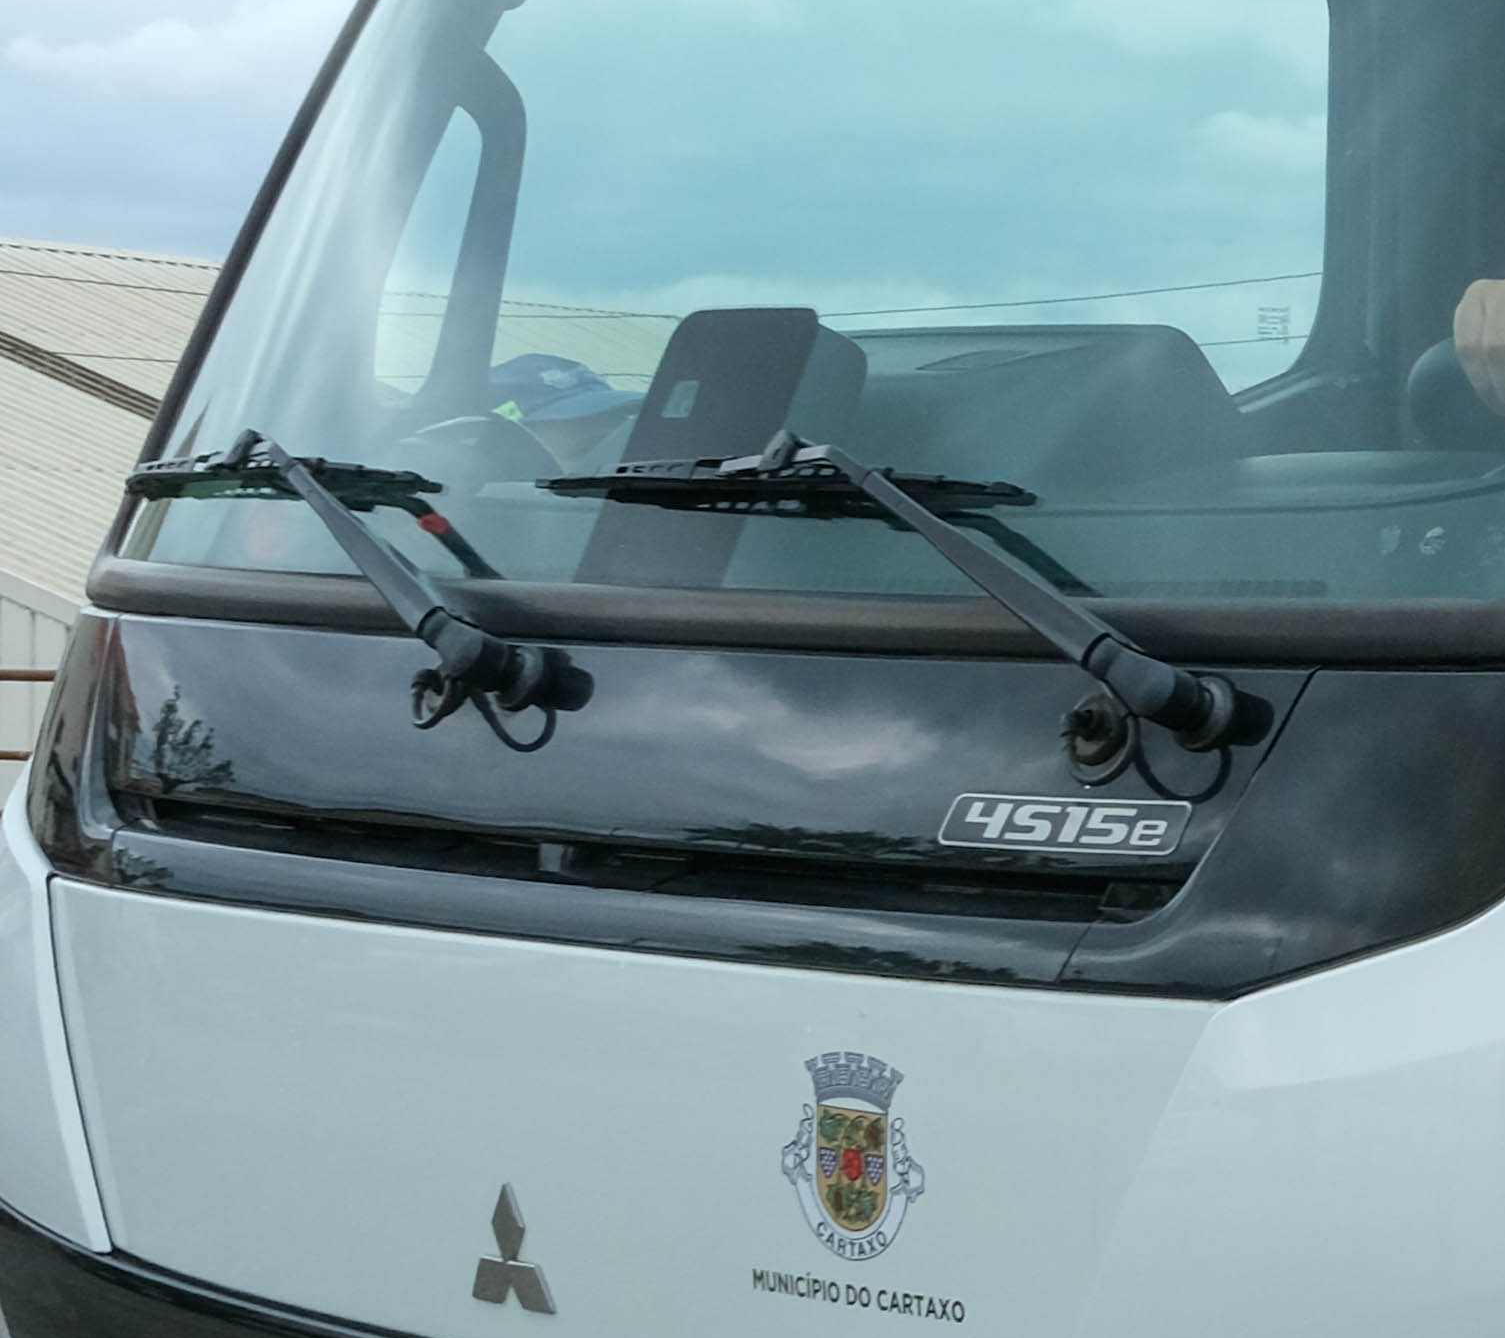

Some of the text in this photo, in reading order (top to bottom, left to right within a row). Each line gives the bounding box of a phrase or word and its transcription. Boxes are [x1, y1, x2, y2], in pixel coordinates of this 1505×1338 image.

[964, 801, 1168, 846] 4S15e
[815, 1221, 888, 1256] CARTAXO
[752, 1268, 966, 1323] MUNICÍPIO DO CARTAXO
